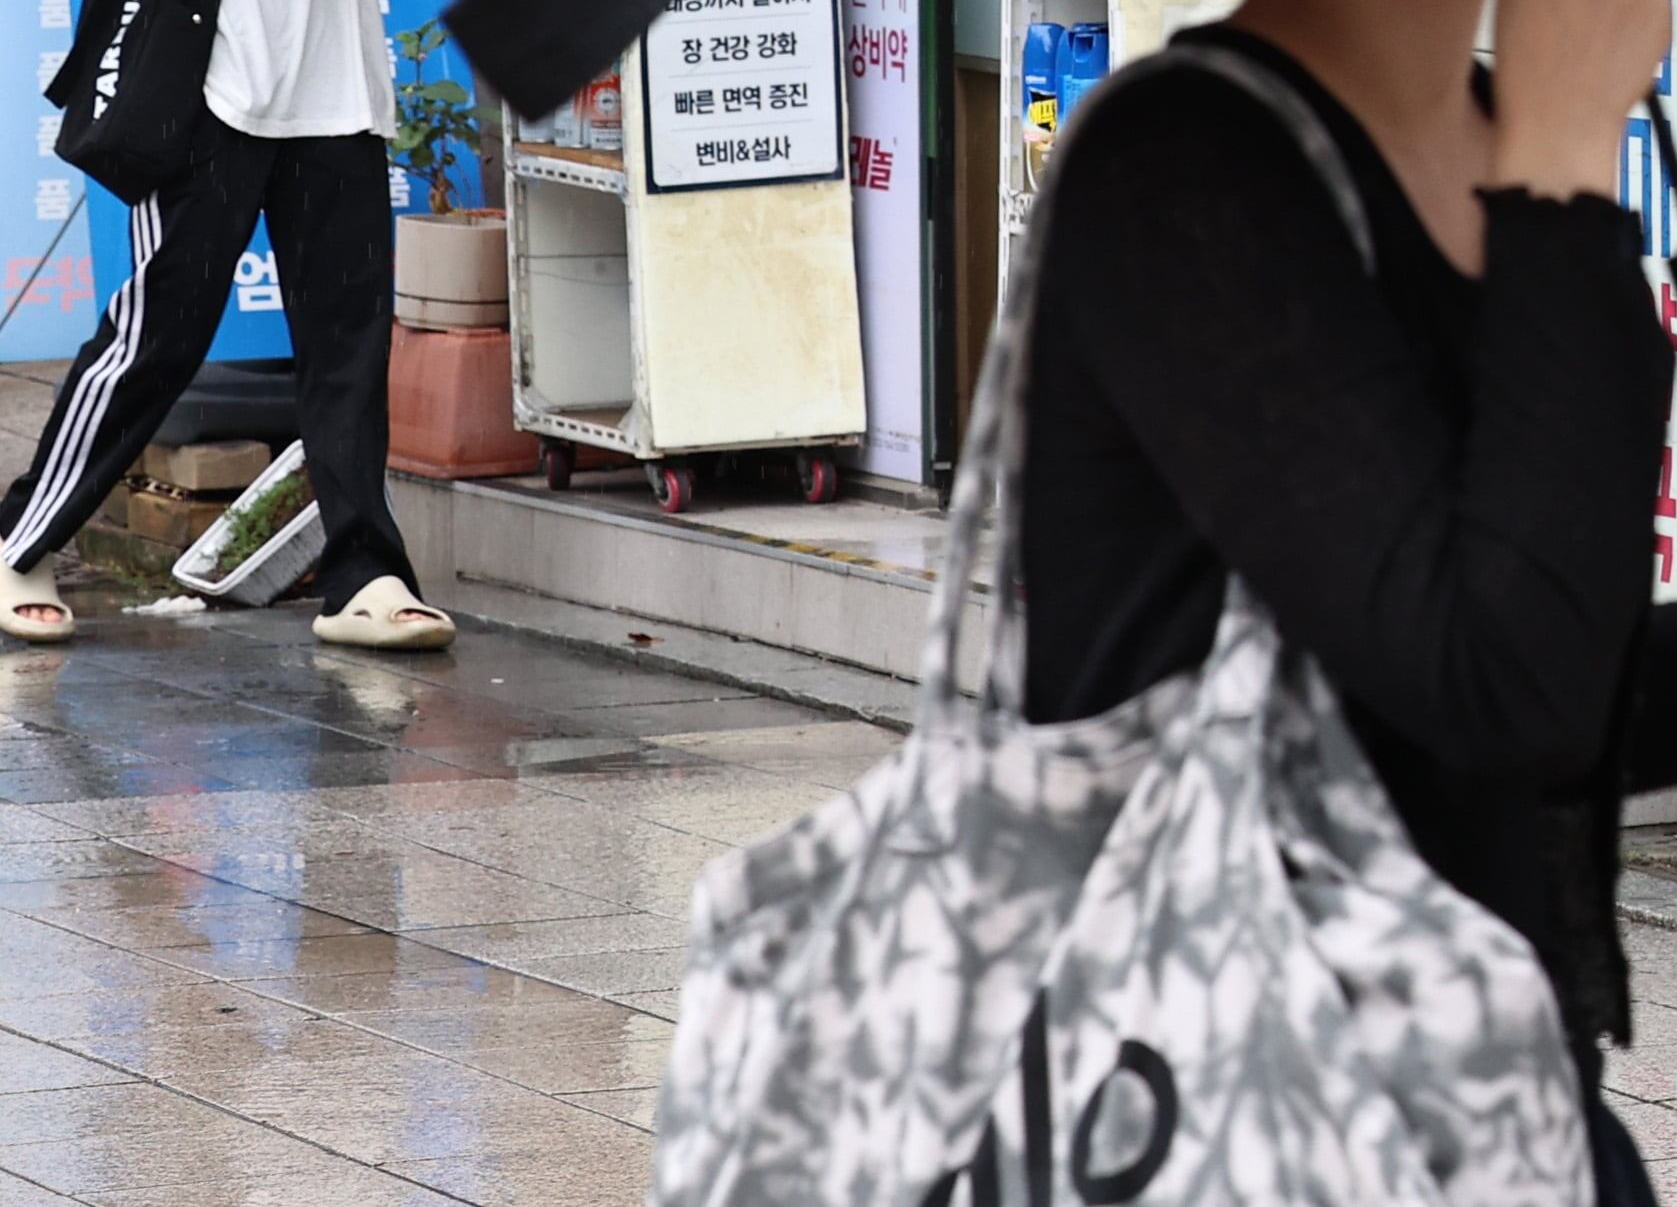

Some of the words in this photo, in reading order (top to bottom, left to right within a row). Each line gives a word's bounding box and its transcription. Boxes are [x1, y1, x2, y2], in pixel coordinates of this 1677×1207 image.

[681, 38, 702, 65] 장
[709, 36, 750, 62] 건강
[757, 32, 797, 61] 강화
[674, 90, 715, 115] 빠른
[722, 88, 761, 113] 면역
[768, 82, 809, 109] 증진
[696, 135, 792, 166] 변비&설사
